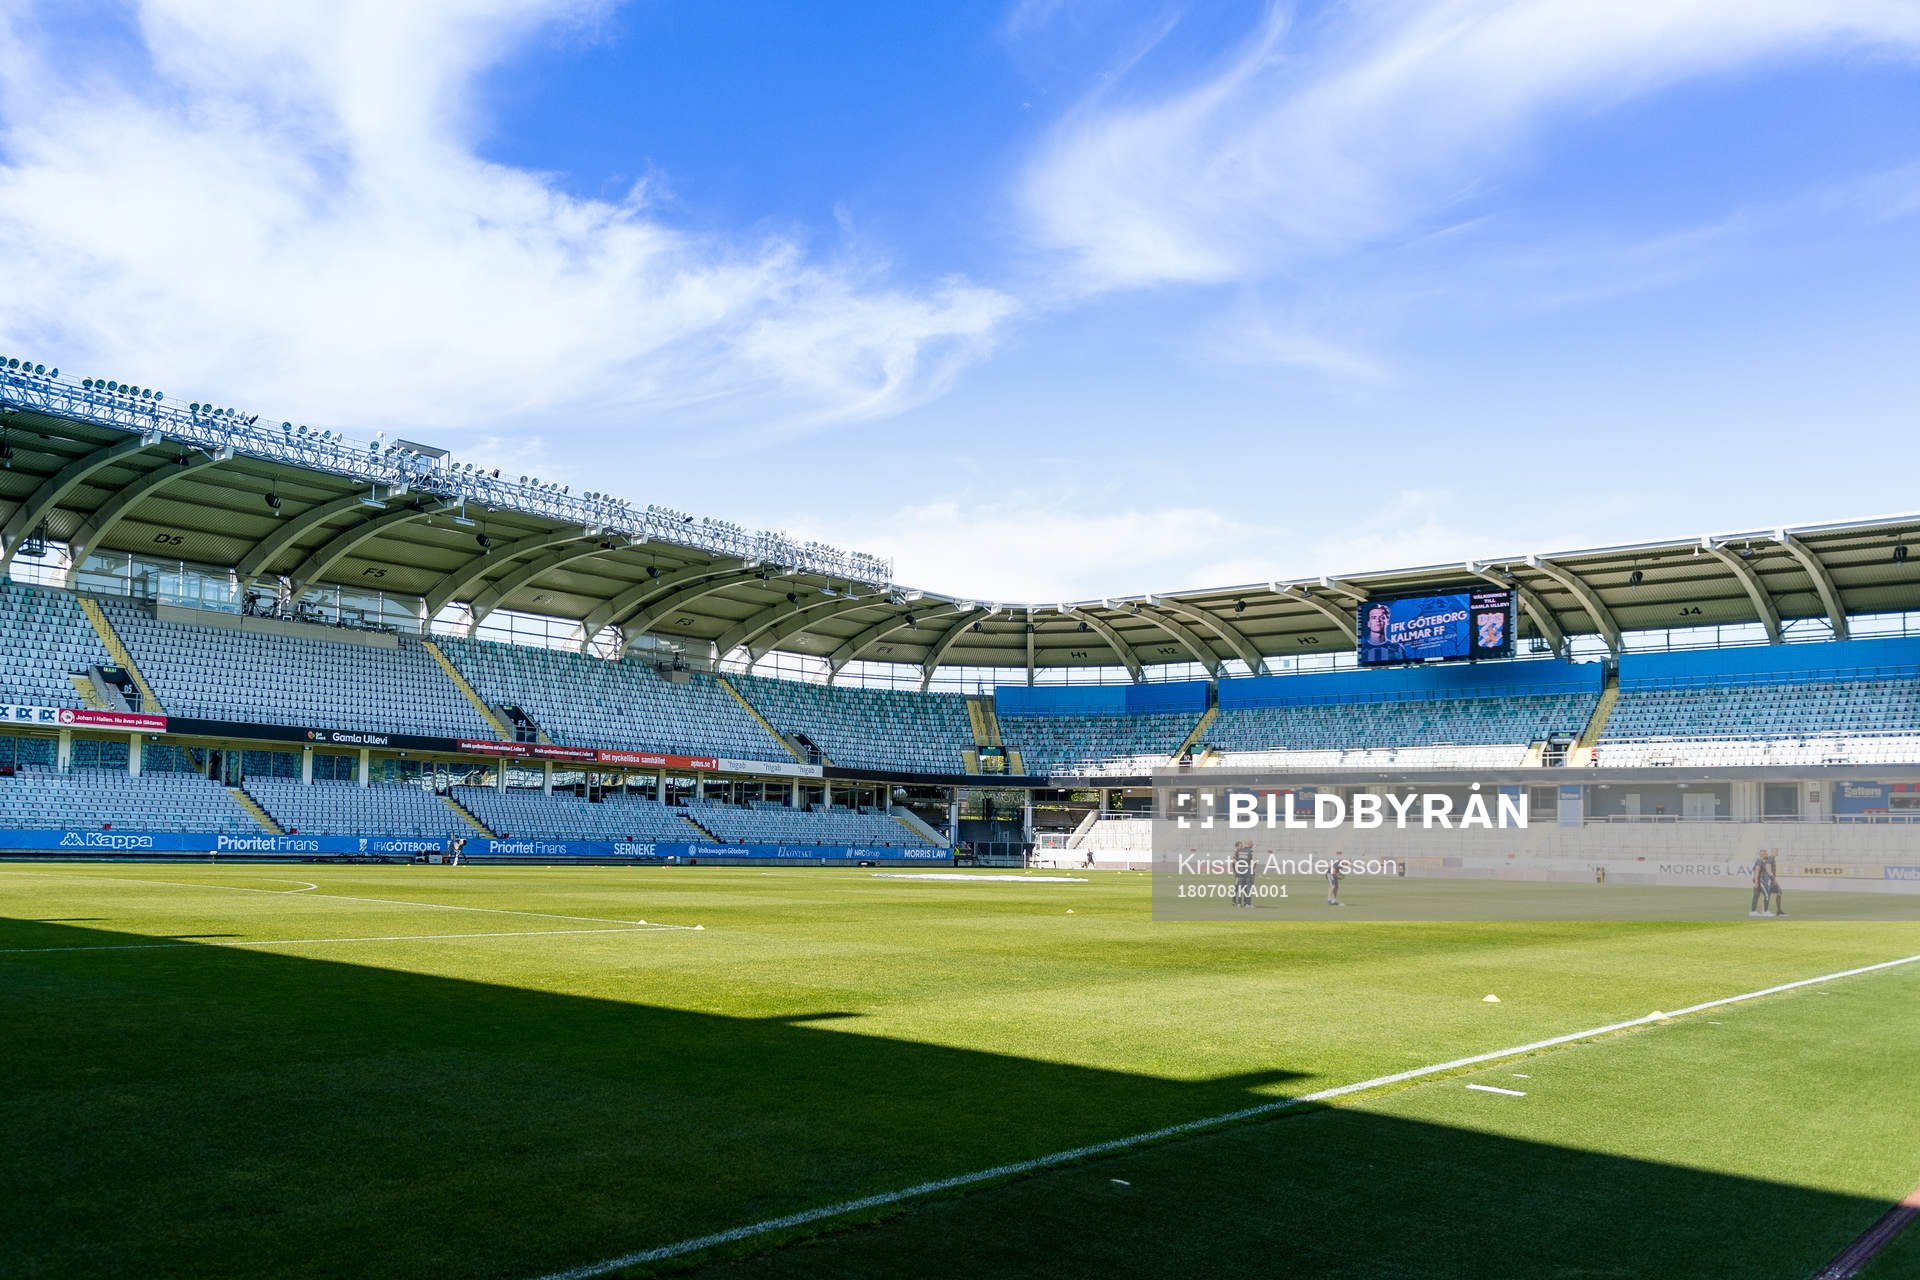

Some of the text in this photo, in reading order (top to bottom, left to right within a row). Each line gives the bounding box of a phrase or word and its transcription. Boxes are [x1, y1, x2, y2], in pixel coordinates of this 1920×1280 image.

[153, 533, 184, 545] D5
[362, 567, 387, 578] F5
[1391, 622, 1405, 632] IFK
[1407, 611, 1468, 627] GÖTEBORG
[1391, 628, 1432, 643] KALMAR
[1434, 626, 1446, 636] FF
[1296, 636, 1320, 645] H3
[1070, 651, 1088, 659] H1
[1157, 647, 1178, 655] H2
[332, 732, 361, 742] Gamla
[363, 734, 388, 744] Ullevi
[601, 752, 611, 761] Det
[612, 753, 640, 763] nyckellösa
[86, 832, 153, 849] Kappa
[217, 835, 319, 850] Prioritet Finans
[489, 840, 567, 855] Prioritet Finans
[613, 843, 656, 856] SERNEKE
[697, 847, 749, 856] Volkswagen Göteborg
[904, 849, 947, 858] MORRIS LAW
[1659, 864, 1721, 875] MORRIS
[1804, 867, 1843, 875] HECO
